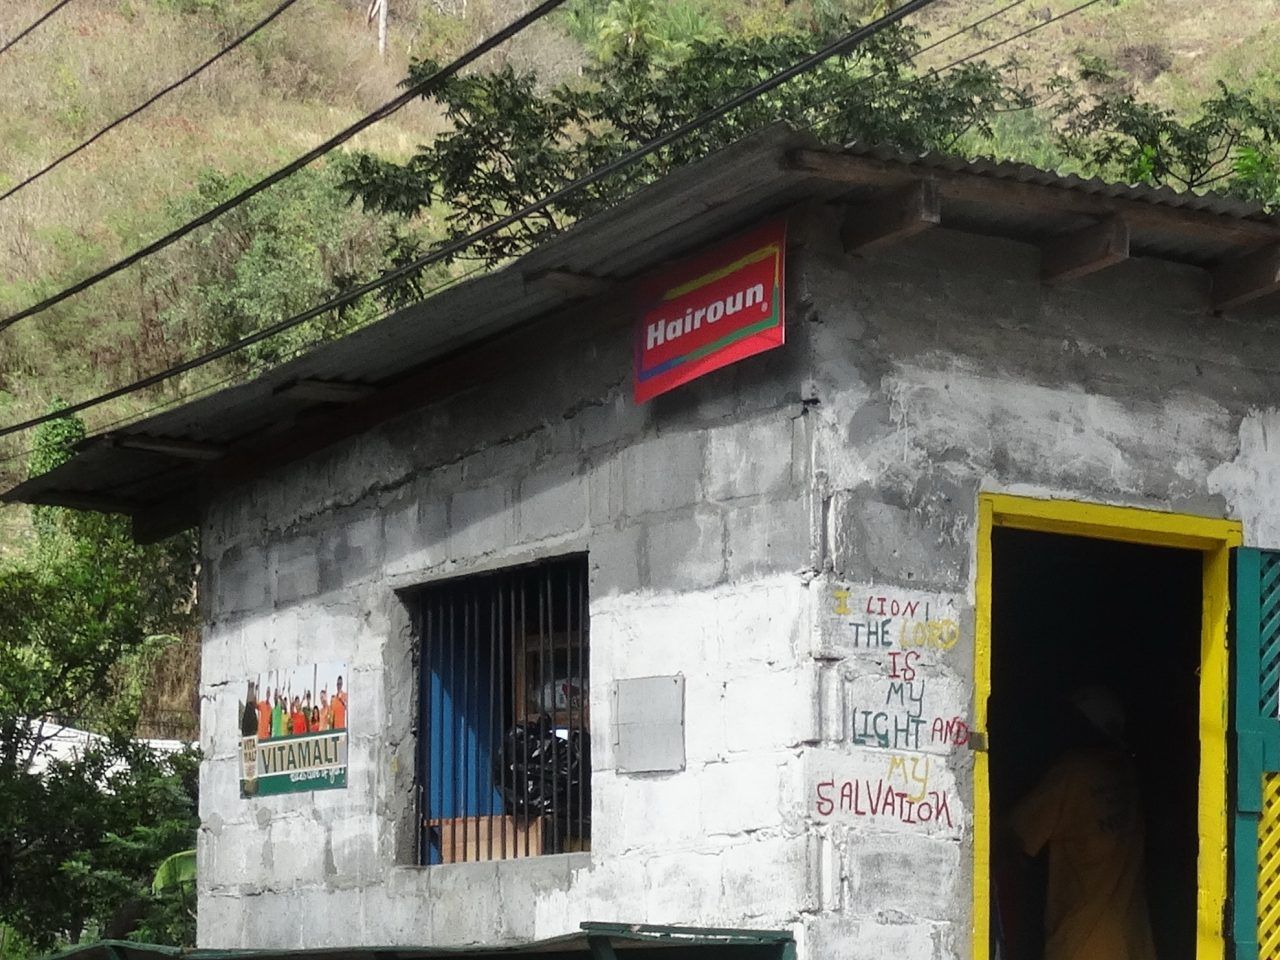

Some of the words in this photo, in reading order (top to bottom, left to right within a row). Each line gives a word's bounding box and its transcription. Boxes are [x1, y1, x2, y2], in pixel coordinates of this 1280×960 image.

[646, 283, 764, 350] Hairoun
[866, 596, 920, 618] LION
[849, 619, 893, 648] THE
[899, 620, 960, 650] LORD
[887, 651, 922, 681] IS
[886, 681, 925, 719] MY
[852, 708, 928, 749] LIGHT
[932, 717, 971, 745] AND
[261, 736, 340, 774] VITAMALT
[887, 756, 930, 802] MY
[816, 779, 954, 829] SALVATION
